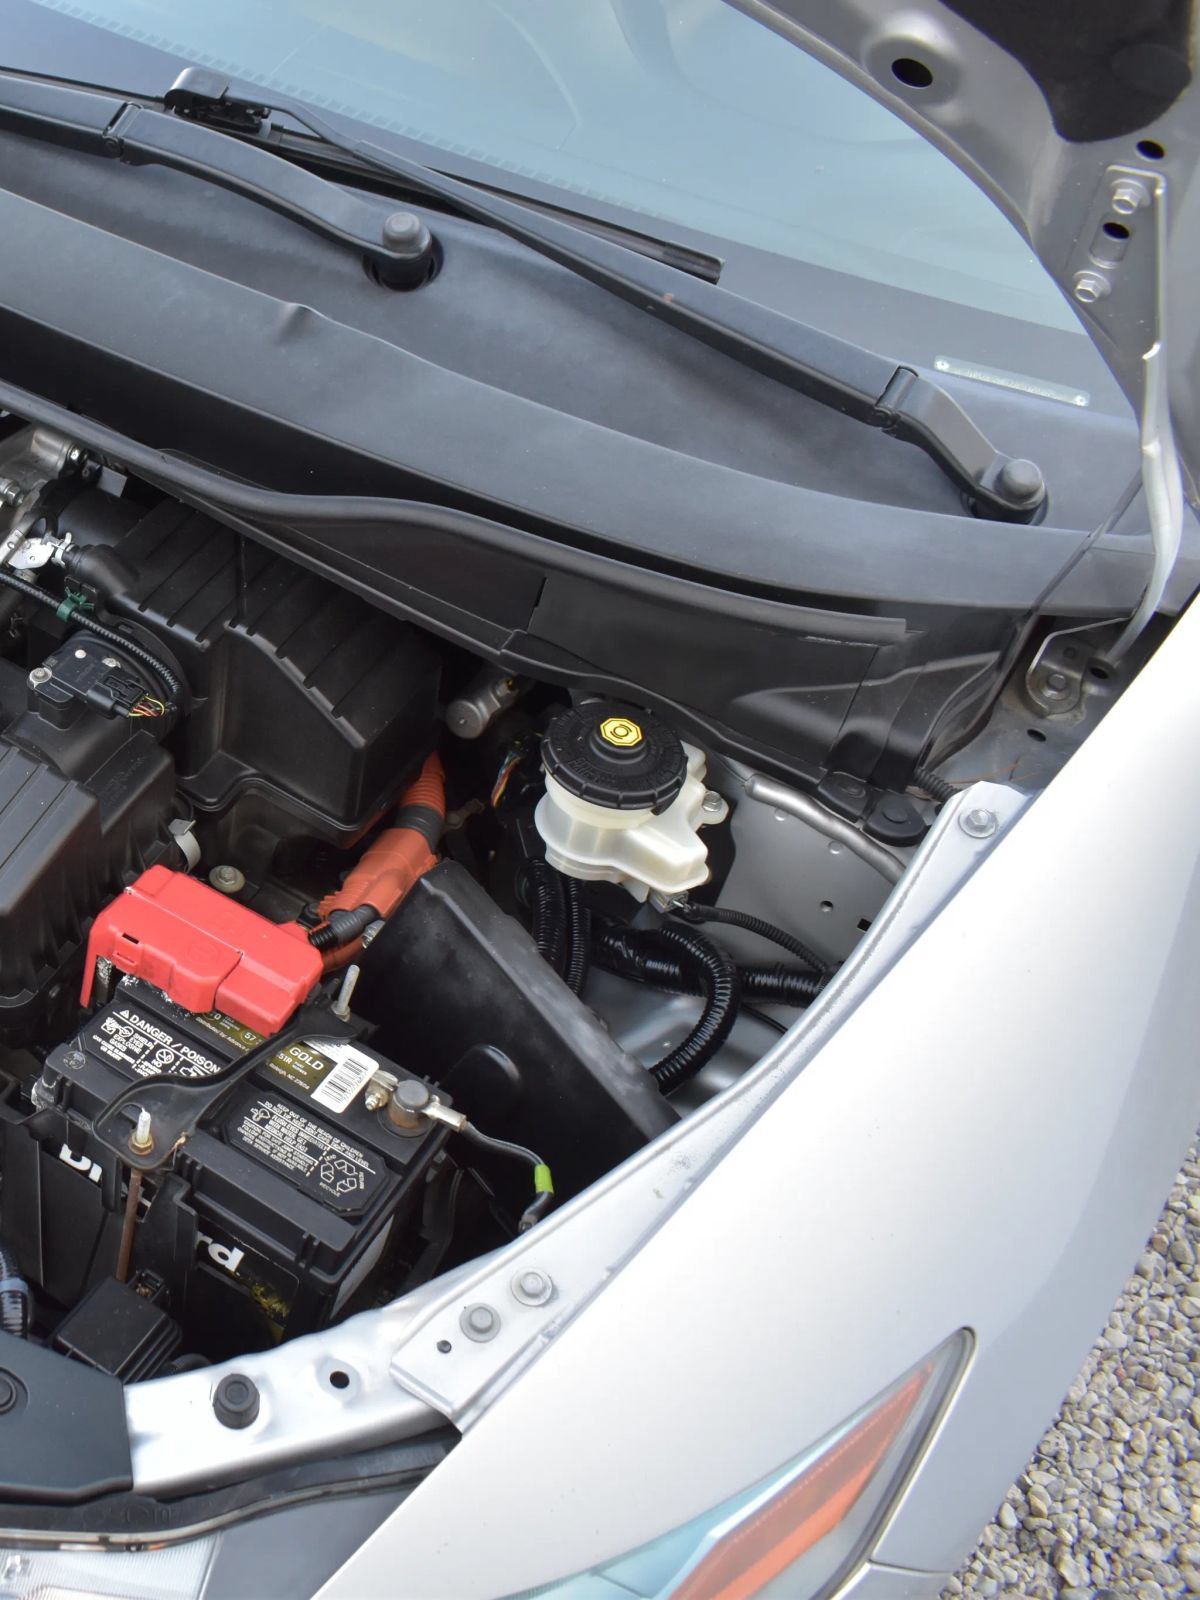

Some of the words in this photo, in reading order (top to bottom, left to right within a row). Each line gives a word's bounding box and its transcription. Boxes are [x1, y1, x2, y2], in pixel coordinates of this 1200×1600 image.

[112, 1033, 142, 1054] EXPLOSIVE
[128, 1036, 144, 1048] EYES
[132, 1032, 153, 1047] SHIELD
[243, 1031, 257, 1042] 57
[108, 1037, 127, 1051] GASES
[128, 1014, 174, 1045] DANGER
[179, 1045, 221, 1074] POISON
[150, 1058, 163, 1068] NO
[288, 1045, 325, 1071] GOLD
